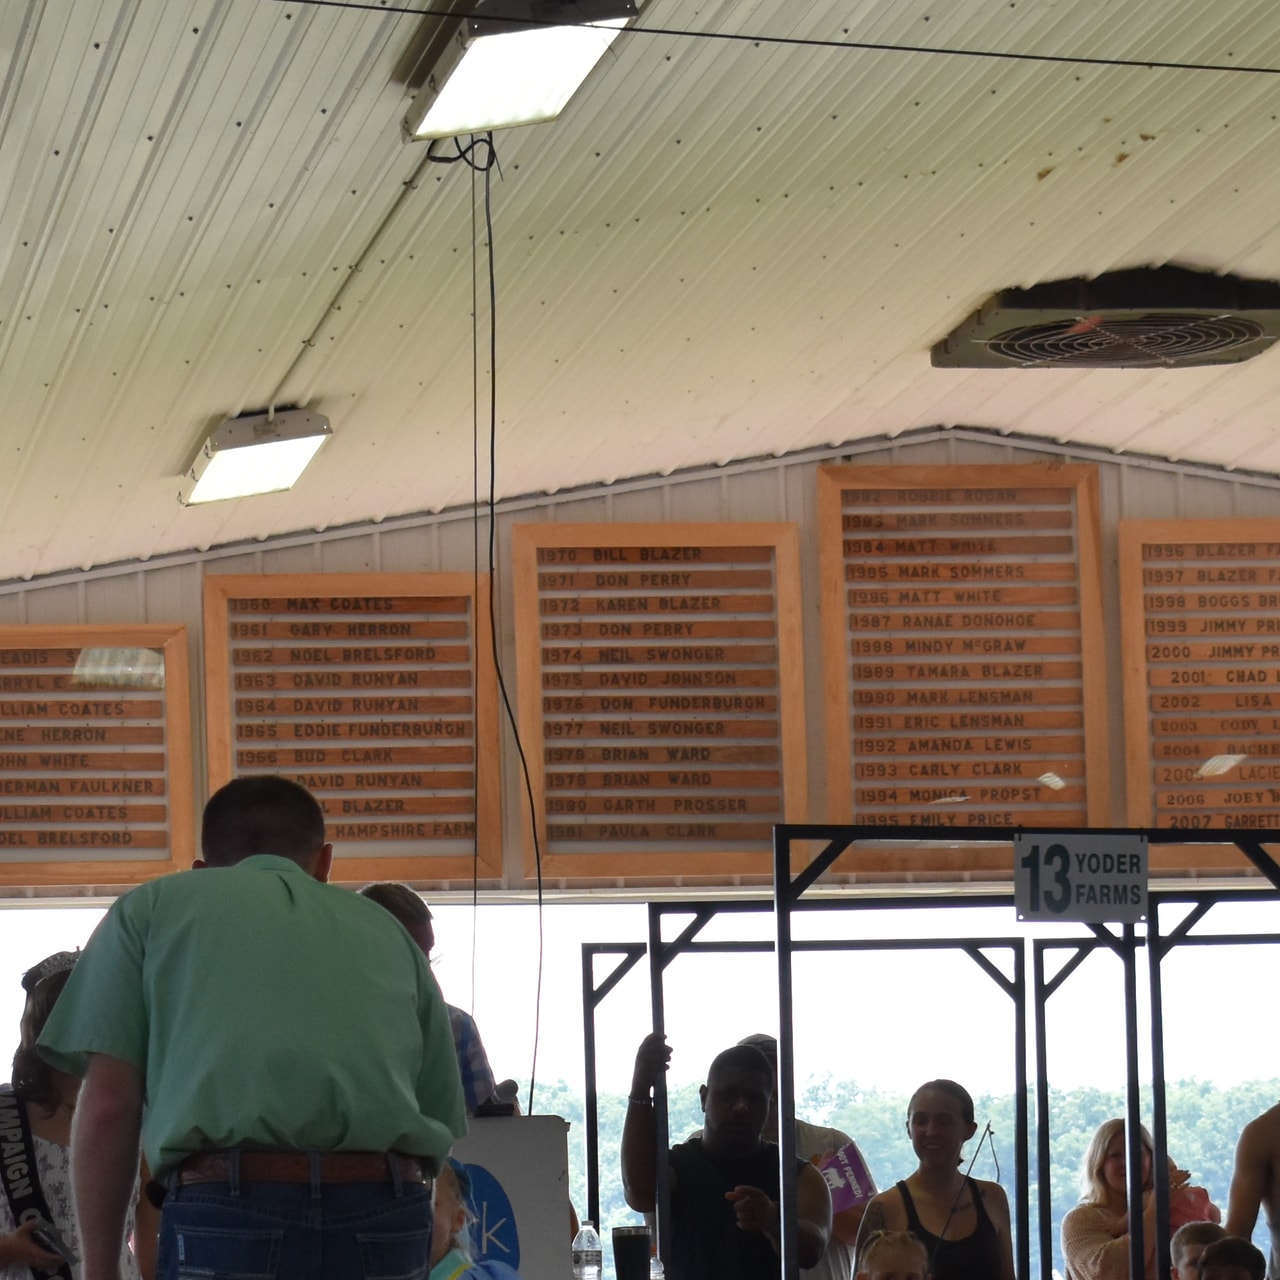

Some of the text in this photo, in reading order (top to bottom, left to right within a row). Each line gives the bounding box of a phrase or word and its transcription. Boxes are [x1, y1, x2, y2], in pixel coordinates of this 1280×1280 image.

[540, 548, 702, 562] 1970 BILL BLAZER
[850, 565, 1025, 579] 1985 MARK SOMMERS
[540, 573, 692, 587] 1971 DON PERRY
[542, 596, 721, 612] 1972 KAREN BLAZER
[851, 589, 1002, 604] 1986 MATT WHITE
[1149, 594, 1186, 608] 1998
[1198, 594, 1250, 608] BOGGS
[853, 613, 1036, 628] 1987 RANAE DONOHOE
[1150, 620, 1187, 633] 1999
[1199, 619, 1247, 633] JIMMY
[232, 623, 412, 638] 1961 GARY HERRON
[544, 622, 694, 636] 1973 DON PERRY
[235, 647, 436, 663] 1962 NOEL BRELSFORD
[544, 647, 725, 662] 1974 NEIL SWONGER
[1151, 645, 1191, 659] 2000
[1208, 645, 1255, 658] JIMMY
[857, 663, 1043, 679] 1989 TAMARA BLAZER
[1171, 670, 1205, 684] 2001
[1226, 669, 1267, 683] CHAD
[59, 702, 125, 716] COATES
[237, 698, 419, 713] 1964 DAVID RUNYAN
[1160, 695, 1200, 709] 2002
[1234, 694, 1273, 708] LISA
[545, 721, 725, 736] 1977 NEIL SWONGER
[859, 714, 1025, 729] 1991 ERIC LENSMAN
[238, 722, 466, 738] 1965 EDDIE FUNDERBURGH
[858, 737, 1032, 753] 1992 AMANDA LEWIS
[39, 754, 90, 768] WHITE
[238, 748, 393, 764] 1966 BUD CLARK
[859, 762, 1023, 778] 1993 CARLY CLARK
[69, 780, 154, 794] FAULKNER
[1166, 793, 1205, 806] 2006
[1223, 791, 1264, 804] JOEY
[38, 831, 132, 845] BRELSFORD
[1074, 853, 1141, 874] YODER
[1021, 843, 1072, 914] 13
[1075, 884, 1141, 905] FARMS
